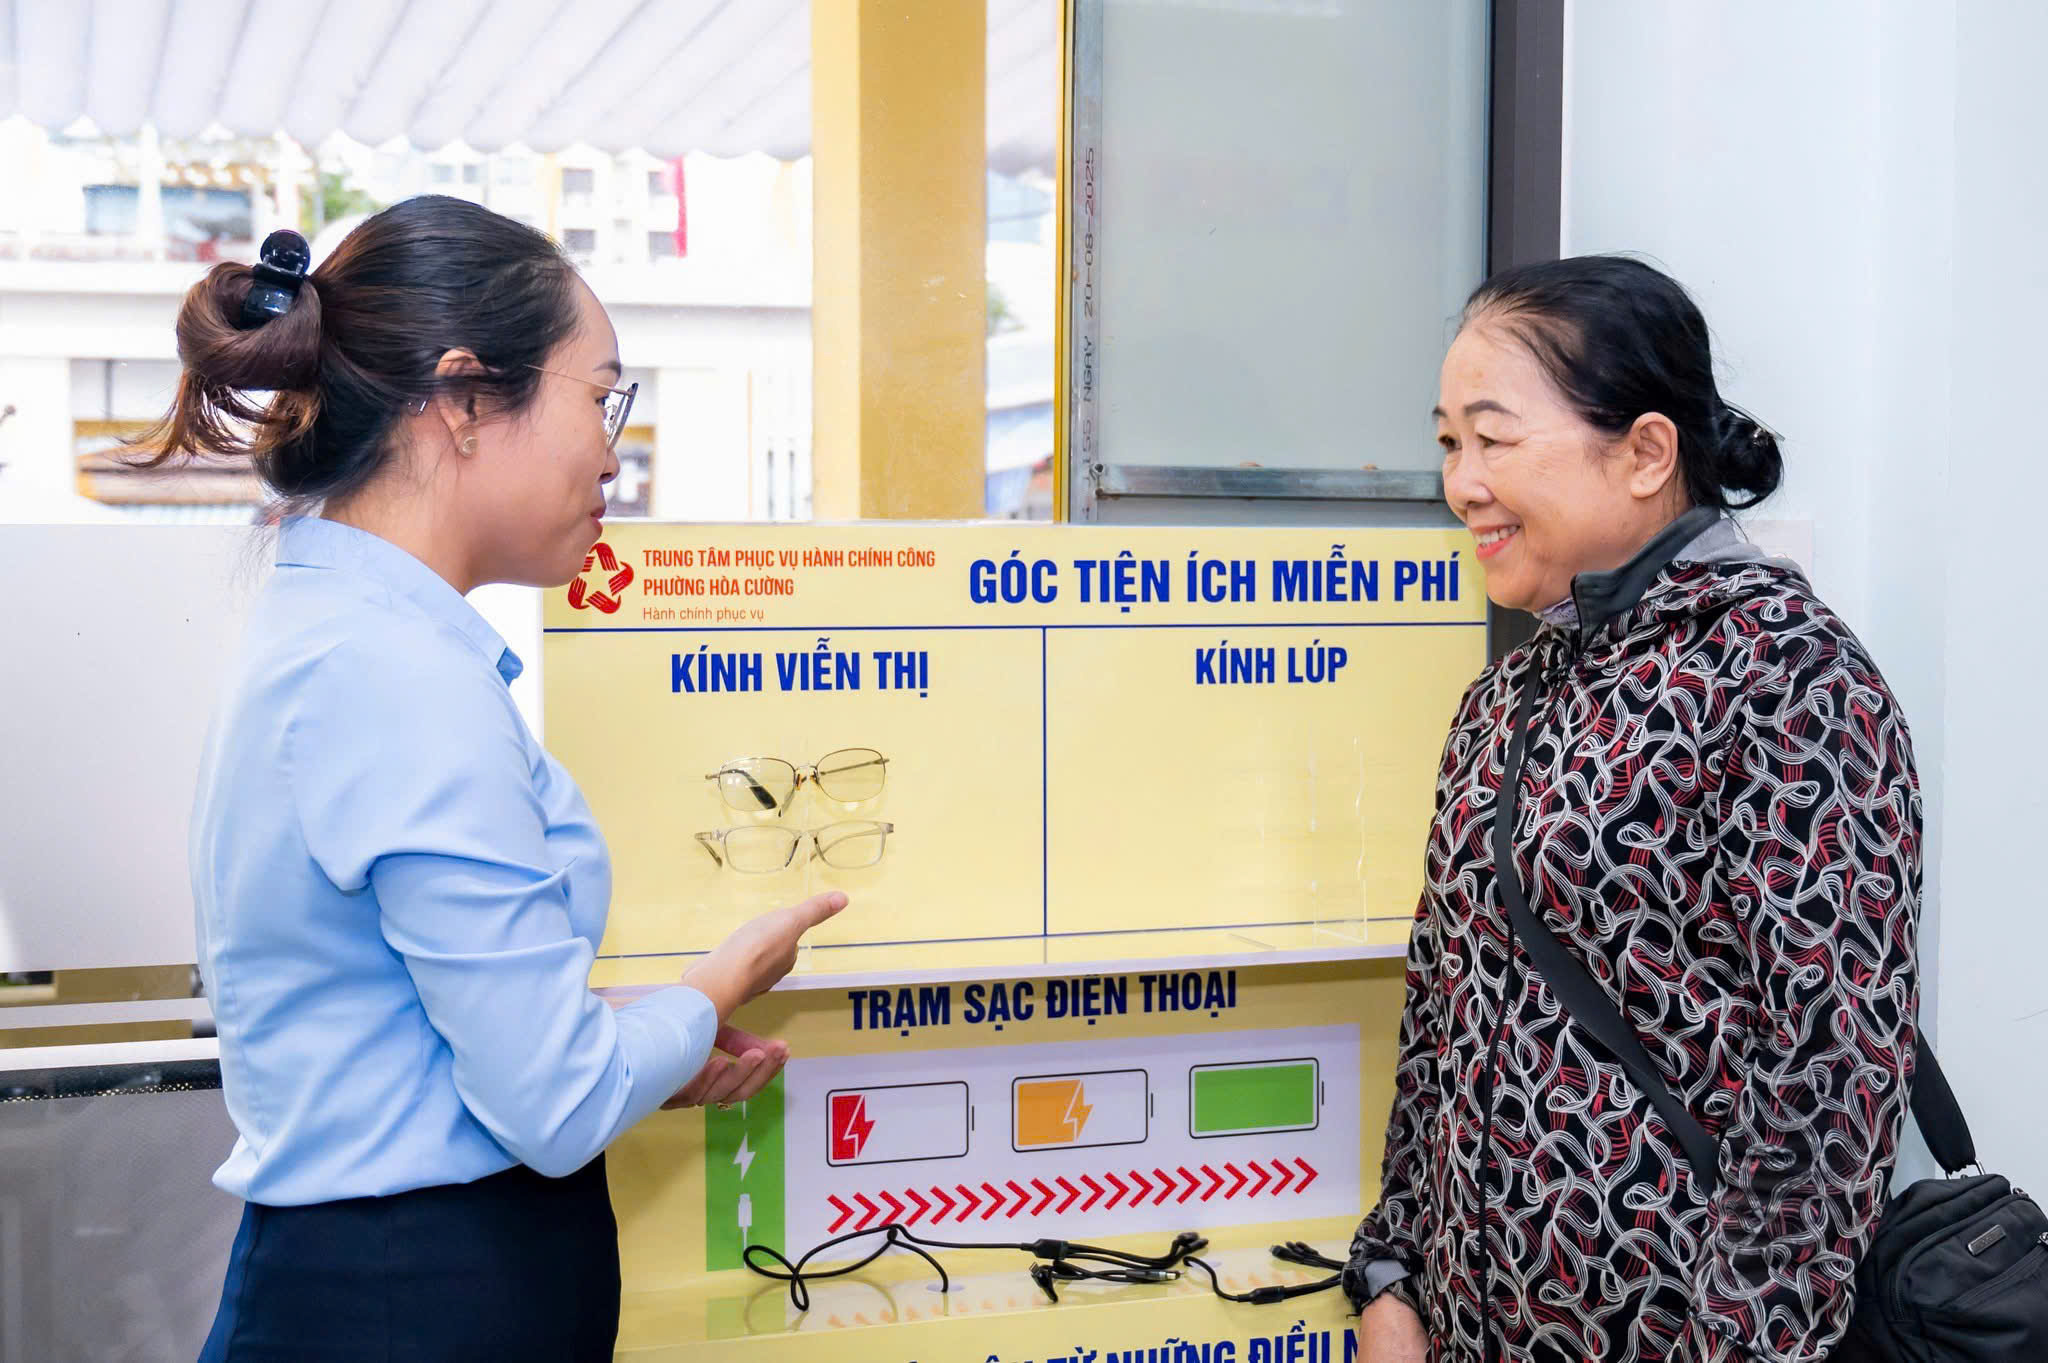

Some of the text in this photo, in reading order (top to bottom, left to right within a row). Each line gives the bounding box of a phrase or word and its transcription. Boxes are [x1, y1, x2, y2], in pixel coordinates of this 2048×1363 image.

[1083, 145, 1095, 318] 20-08-2025
[643, 547, 936, 571] TRUNG TÂM PHỤC VỤ HÀNH CHÍNH CÔNG
[970, 544, 1460, 613] GÓC TIỆN ÍCH MIỄN PHÍ
[643, 575, 795, 597] PHƯỜNG HÒA CƯỜNG
[643, 605, 765, 623] Hành chính phục vụ
[672, 637, 928, 698] KÍNH VIỄN THỊ
[1195, 639, 1348, 685] KÍNH LÚP
[848, 970, 1237, 1037] TRẠM SẠC ĐIỆN THOẠI
[1107, 1337, 1236, 1363] ỮNG
[1248, 1319, 1331, 1363] ĐIỀU
